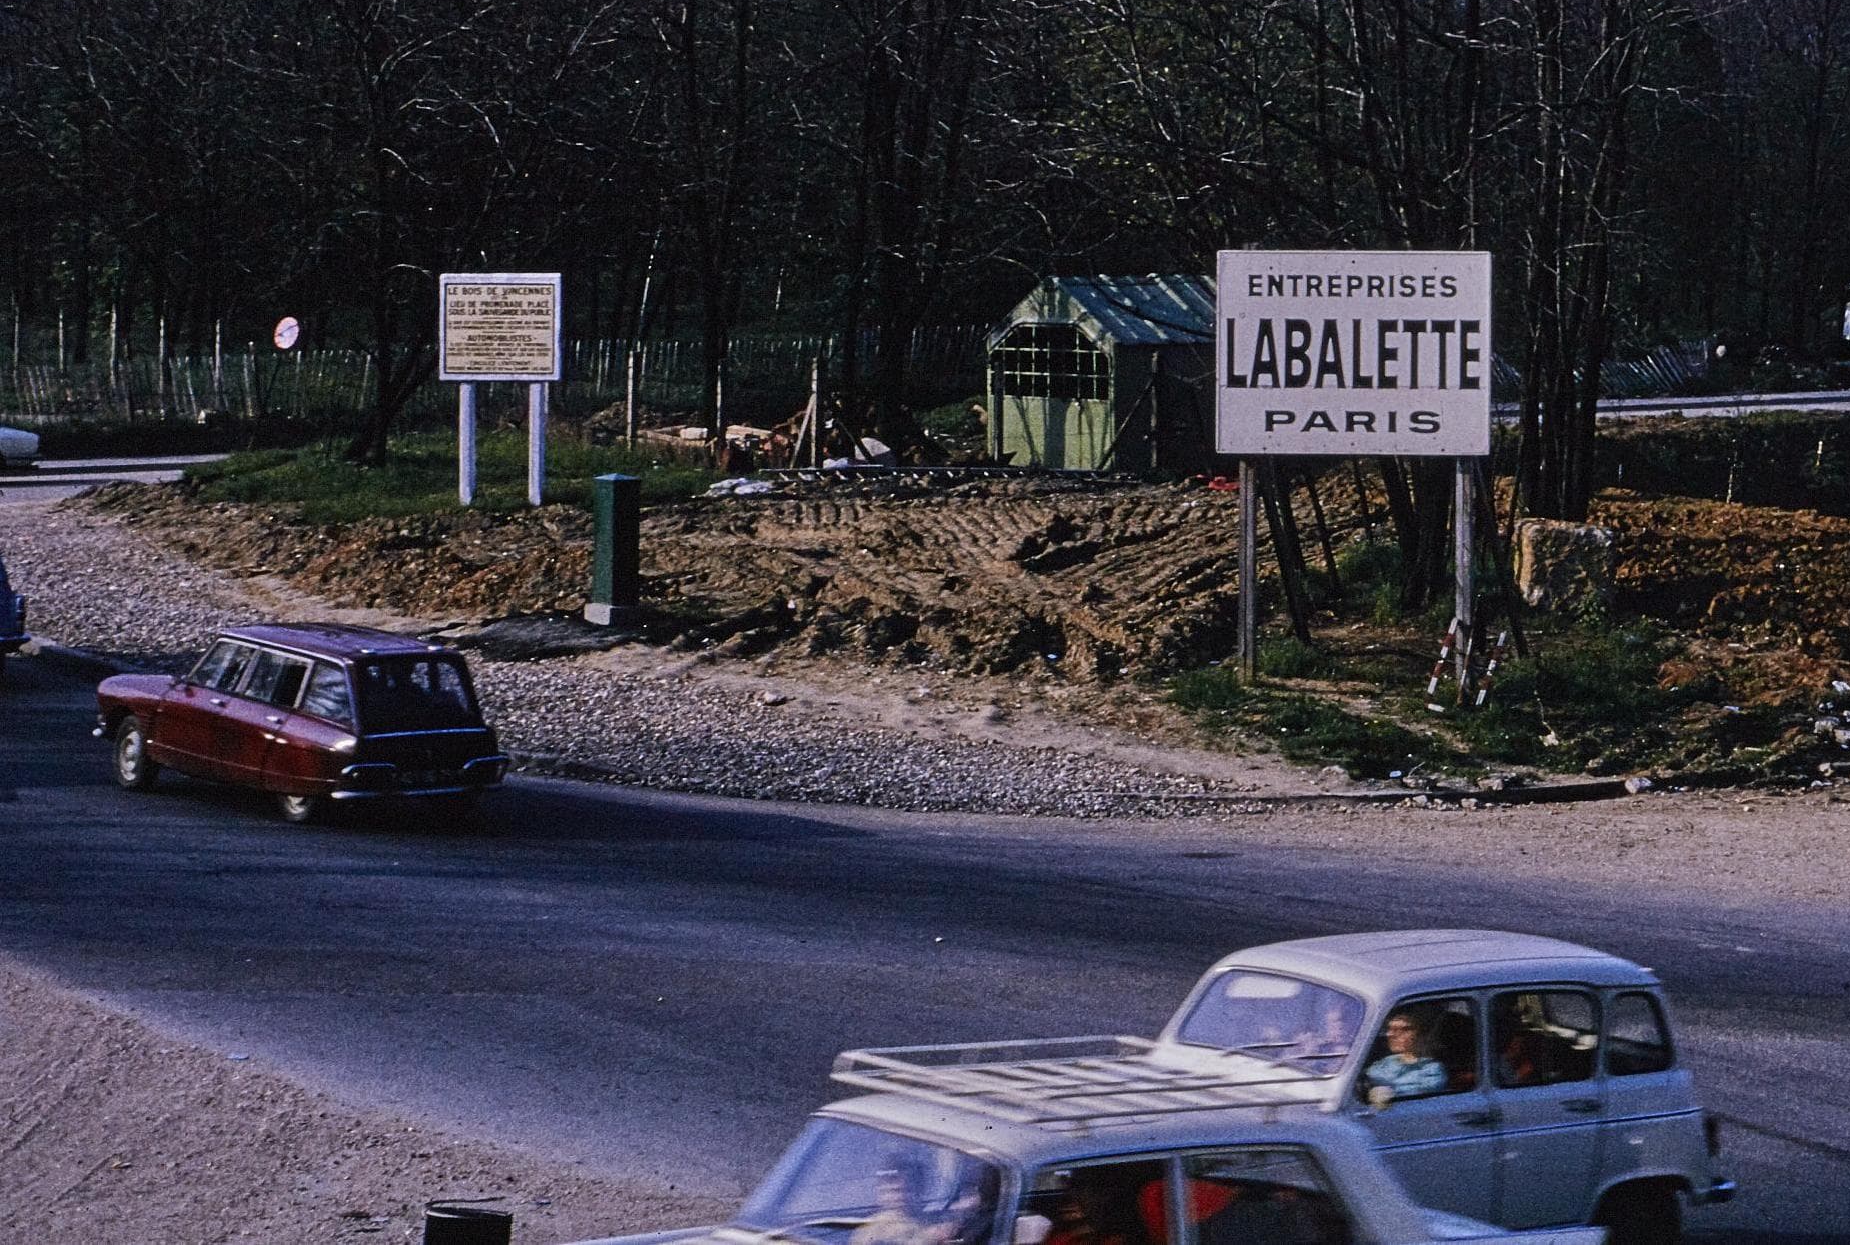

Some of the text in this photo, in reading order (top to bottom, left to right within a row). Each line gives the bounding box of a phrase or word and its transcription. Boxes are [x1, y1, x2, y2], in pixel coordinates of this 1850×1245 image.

[448, 287, 552, 295] LE BOIS DE VINCENNES
[1248, 274, 1457, 298] ENTREPRISES
[1226, 318, 1481, 390] LABALETTE
[1265, 410, 1441, 434] PARIS
